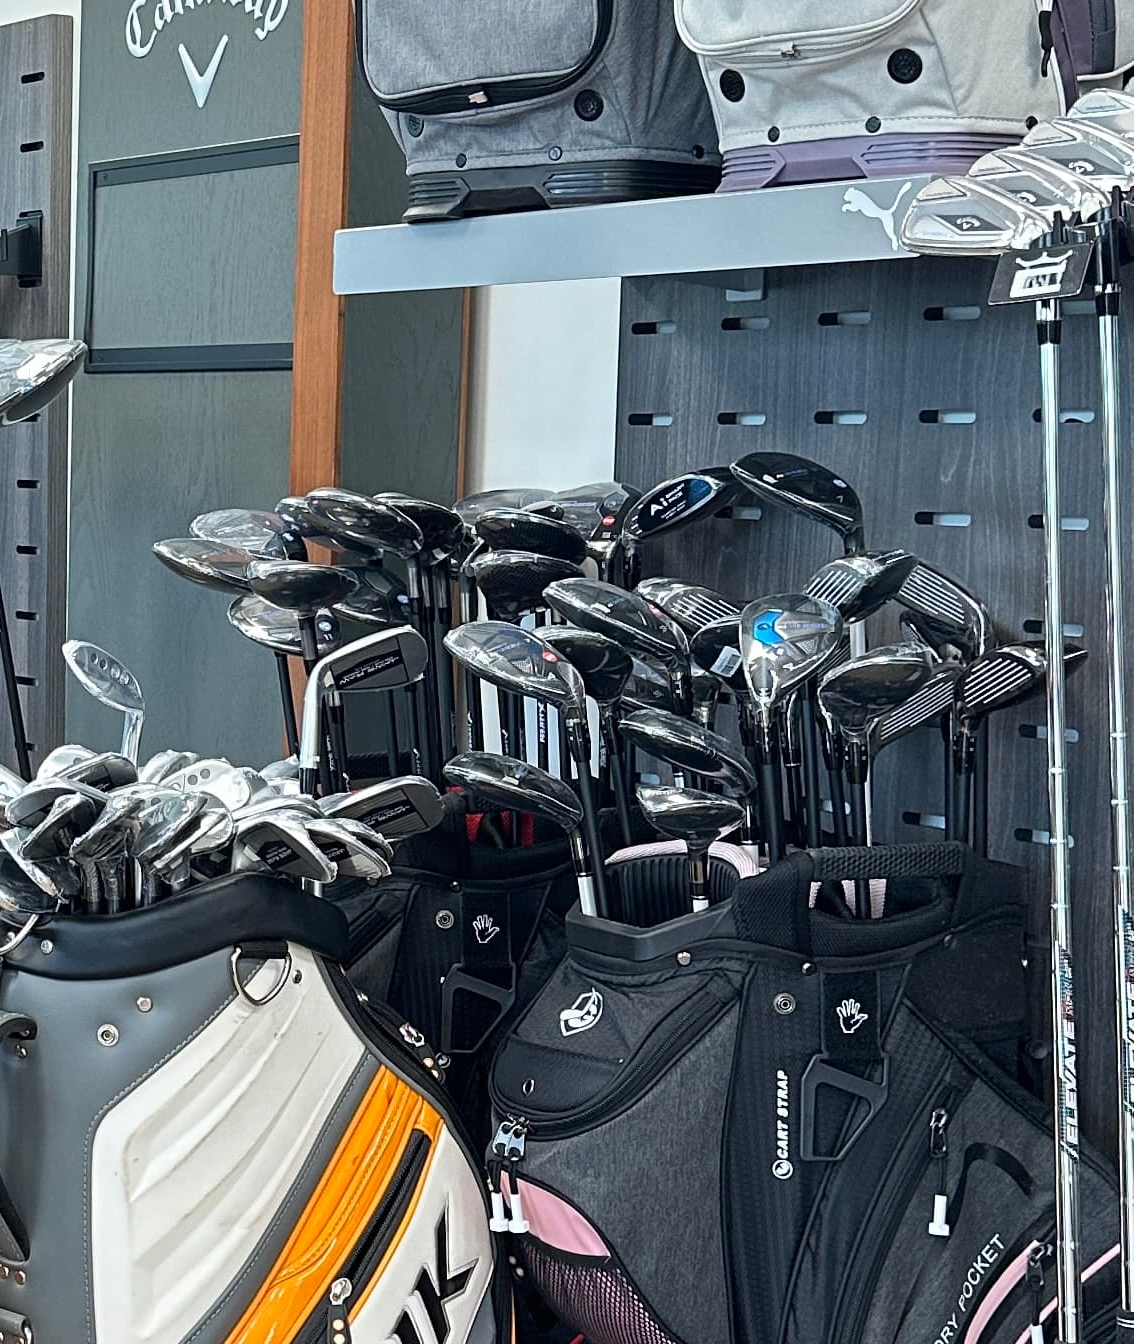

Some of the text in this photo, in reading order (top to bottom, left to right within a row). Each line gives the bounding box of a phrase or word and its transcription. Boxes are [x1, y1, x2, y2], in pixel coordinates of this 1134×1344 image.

[777, 1070, 788, 1159] CART STRAP
[1066, 1020, 1078, 1146] ELEVATE
[957, 1233, 1004, 1312] POCKET
